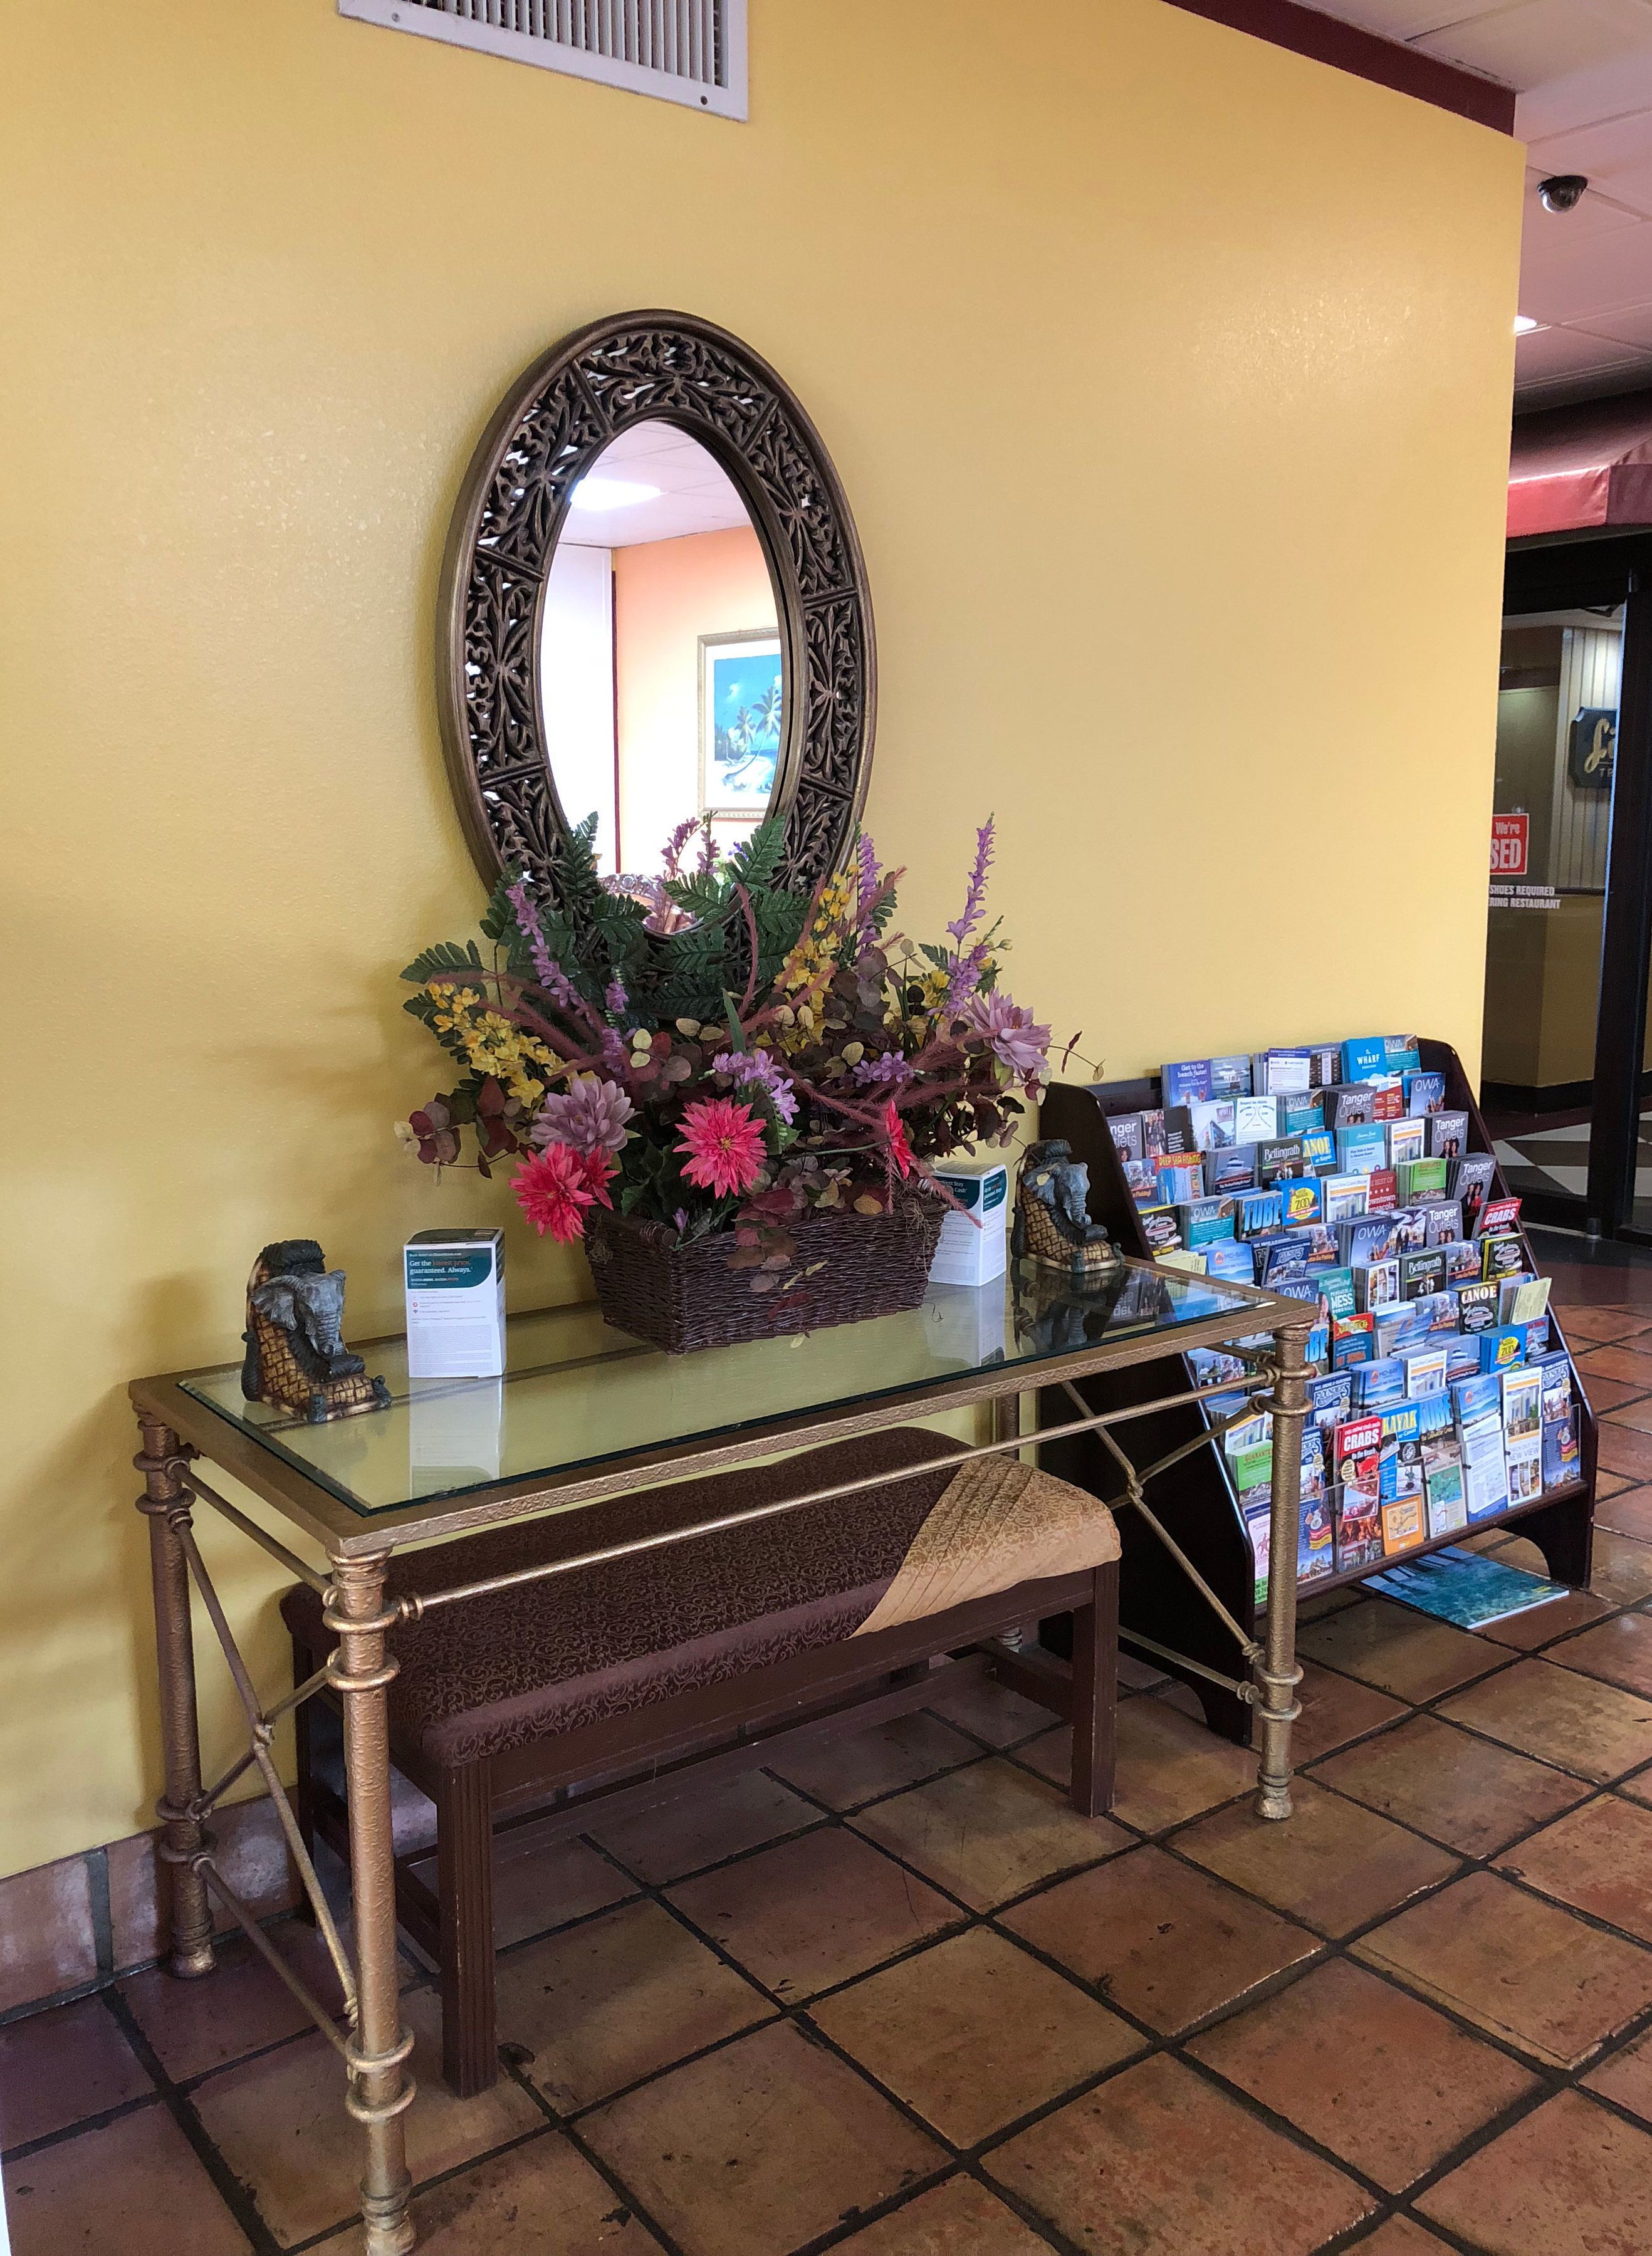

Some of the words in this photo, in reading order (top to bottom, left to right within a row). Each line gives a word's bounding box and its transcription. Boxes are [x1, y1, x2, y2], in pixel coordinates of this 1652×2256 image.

[1495, 822, 1520, 835] We're
[1490, 838, 1522, 869] SED
[1490, 885, 1515, 894] SHOES
[1516, 886, 1555, 896] REQUIRED
[1510, 898, 1561, 909] RESTAURANT
[1384, 1038, 1403, 1048] OWA
[1357, 1054, 1380, 1065] WHARF
[1414, 1077, 1440, 1092] OWA
[1289, 1096, 1309, 1107] OWA
[1341, 1092, 1374, 1106] Tanger
[1339, 1104, 1371, 1118] Outlets
[1111, 1122, 1137, 1137] nger
[1436, 1117, 1465, 1131] Tanger
[1435, 1129, 1465, 1143] Outlets
[1264, 1144, 1300, 1161] Bellingrath
[1463, 1161, 1493, 1174] Tanger
[1460, 1172, 1490, 1186] Outlets
[1295, 1198, 1310, 1210] ZOO
[1193, 1206, 1216, 1218] OWA
[1243, 1195, 1282, 1232] TUBE
[1429, 1207, 1458, 1221] Tanger
[1485, 1208, 1517, 1225] CRABS
[1357, 1224, 1387, 1240] OWA
[1429, 1218, 1459, 1233] Outlets
[409, 1267, 446, 1275] guaranteed.
[1408, 1256, 1441, 1274] Bellingrath
[1283, 1285, 1313, 1298] OWA
[1461, 1285, 1497, 1304] CANOE
[1331, 1293, 1354, 1309] MESS
[1344, 1428, 1379, 1452] CRABS
